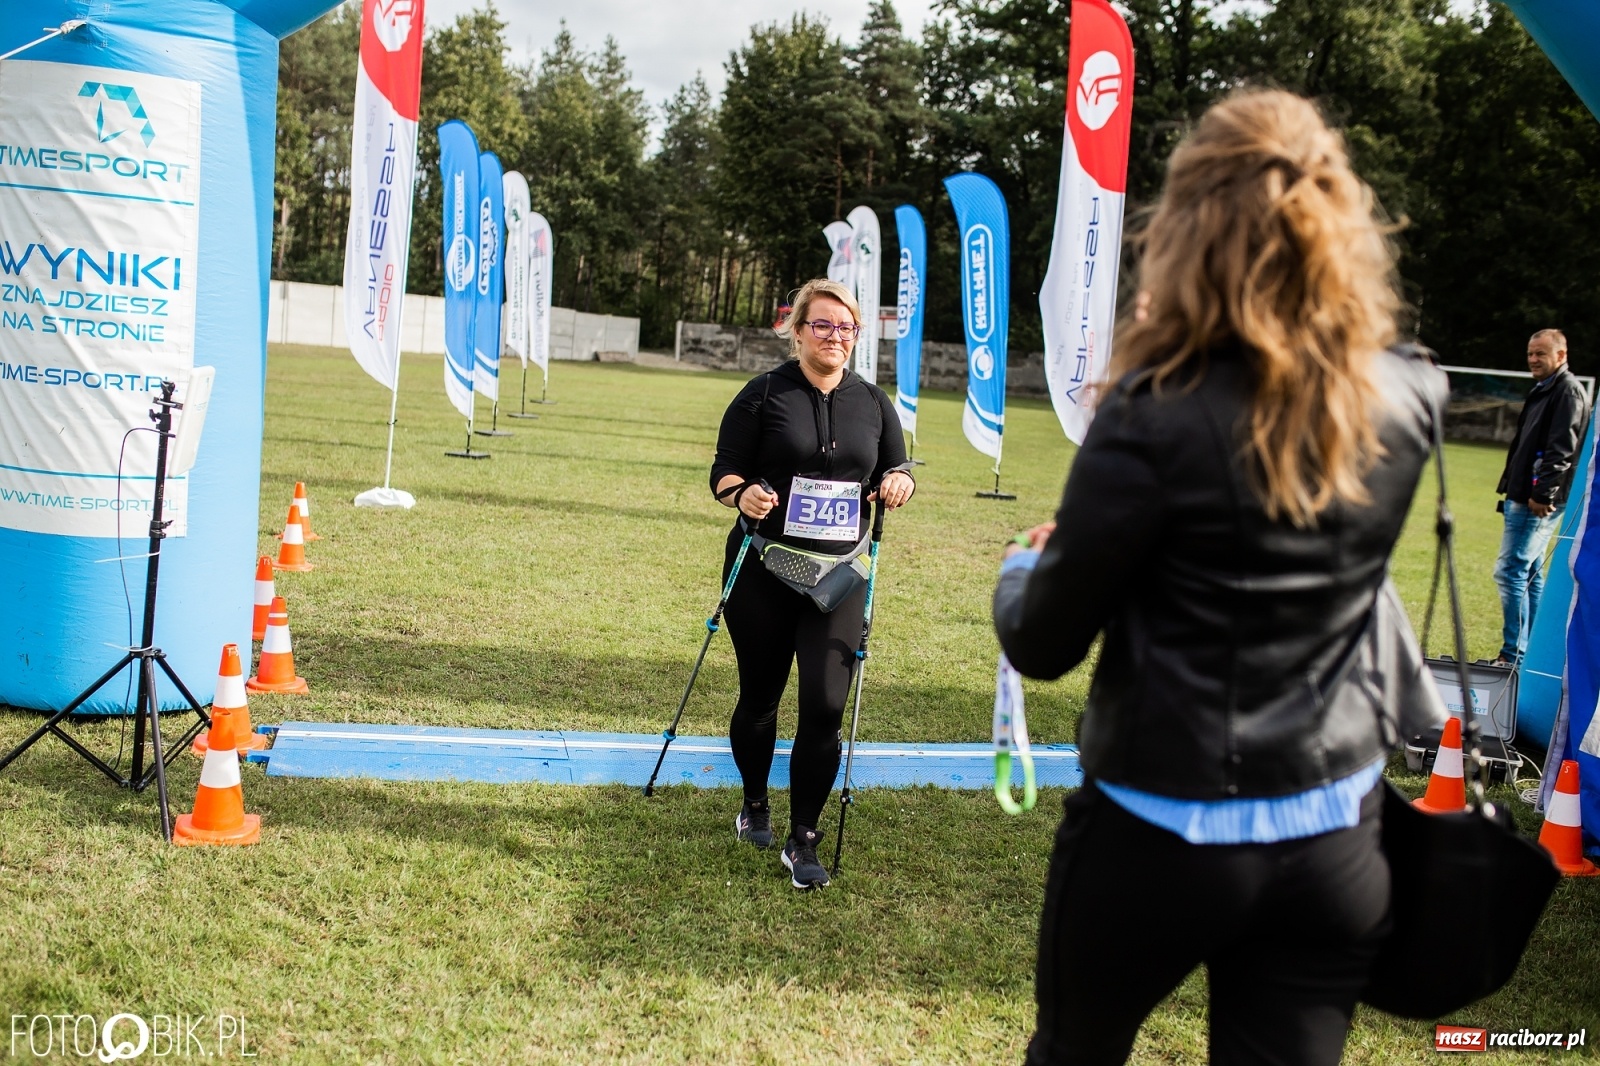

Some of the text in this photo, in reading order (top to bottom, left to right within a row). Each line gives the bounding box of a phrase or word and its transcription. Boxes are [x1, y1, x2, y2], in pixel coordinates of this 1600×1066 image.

[0, 145, 190, 183] TIMESPORT
[0, 240, 181, 291] WYNIKI
[1, 283, 168, 316] ZNAJDZIESZ
[2, 311, 165, 342] NA STRONIE
[0, 362, 178, 392] IME-SPORT.P
[798, 498, 850, 526] 348
